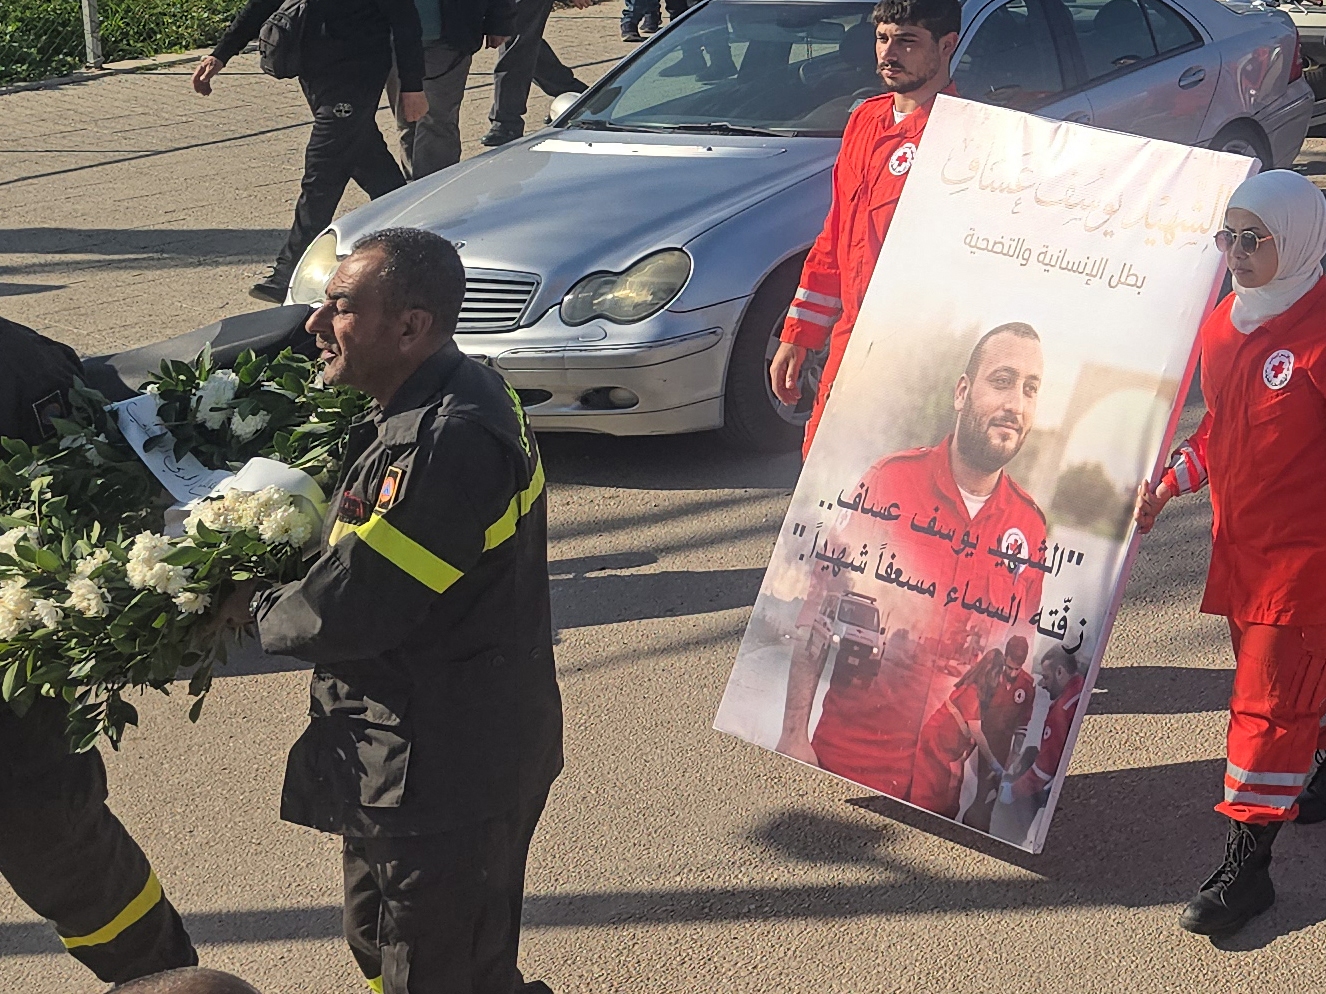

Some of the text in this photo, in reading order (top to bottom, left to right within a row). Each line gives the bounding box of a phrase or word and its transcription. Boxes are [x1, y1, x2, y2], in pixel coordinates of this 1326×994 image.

[963, 227, 1147, 296] بطل الإنسانية والتضحية
[818, 481, 1085, 578] "الشهيد يوسف عساف..
[874, 542, 937, 599] مسعفاً
[943, 580, 1022, 627] السماء
